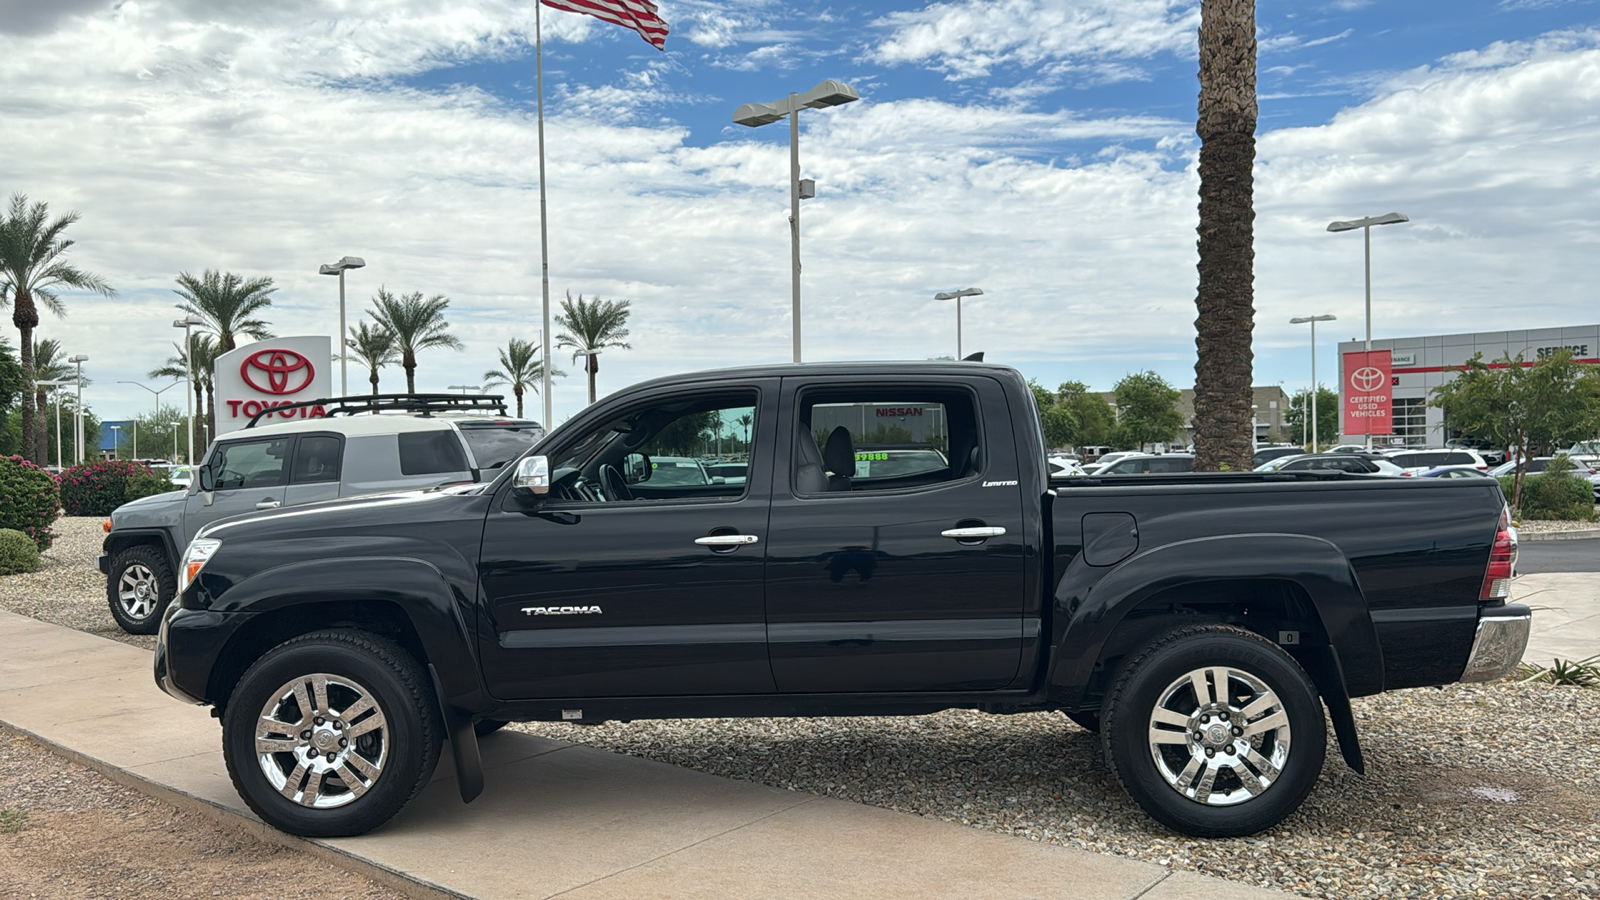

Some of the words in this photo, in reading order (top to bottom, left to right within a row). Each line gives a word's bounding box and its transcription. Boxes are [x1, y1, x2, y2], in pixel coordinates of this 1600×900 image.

[1350, 395, 1386, 403] CERTIFIED
[227, 400, 326, 418] TOYOTA
[876, 407, 923, 417] NISSAN
[521, 605, 602, 616] TACOMA
